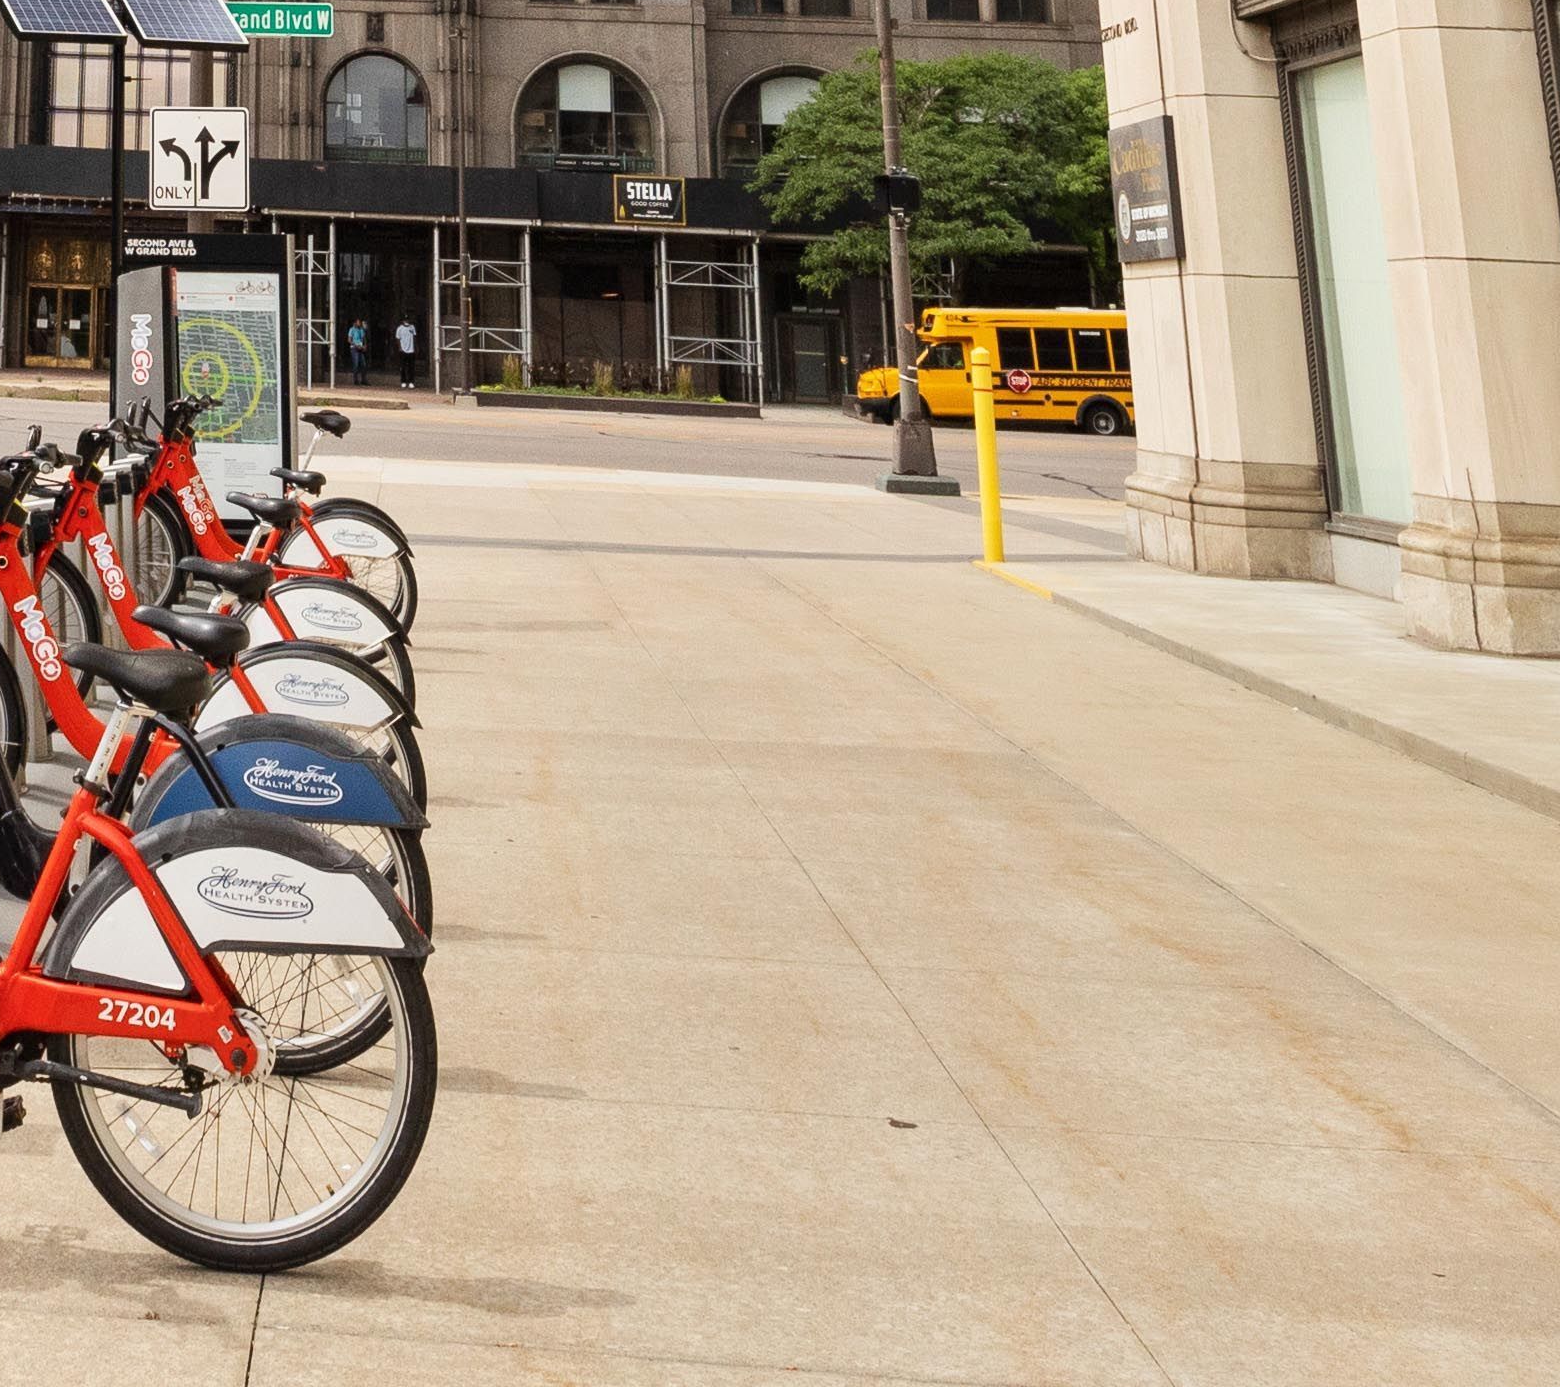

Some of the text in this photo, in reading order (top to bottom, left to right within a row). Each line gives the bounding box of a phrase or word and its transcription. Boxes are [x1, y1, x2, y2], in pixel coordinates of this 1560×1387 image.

[233, 9, 329, 30] rand Blvd W
[155, 186, 193, 199] ONLY
[626, 181, 672, 201] STELLA
[124, 247, 197, 256] W GRAND BLVD
[127, 239, 194, 248] SECOND AVE &
[1011, 376, 1028, 386] STOP
[1037, 378, 1054, 386] ABC
[1059, 378, 1099, 387] STUDENT
[256, 758, 337, 785] Henry Ford
[211, 866, 307, 897] Henry Ford
[98, 998, 176, 1031] 27204
